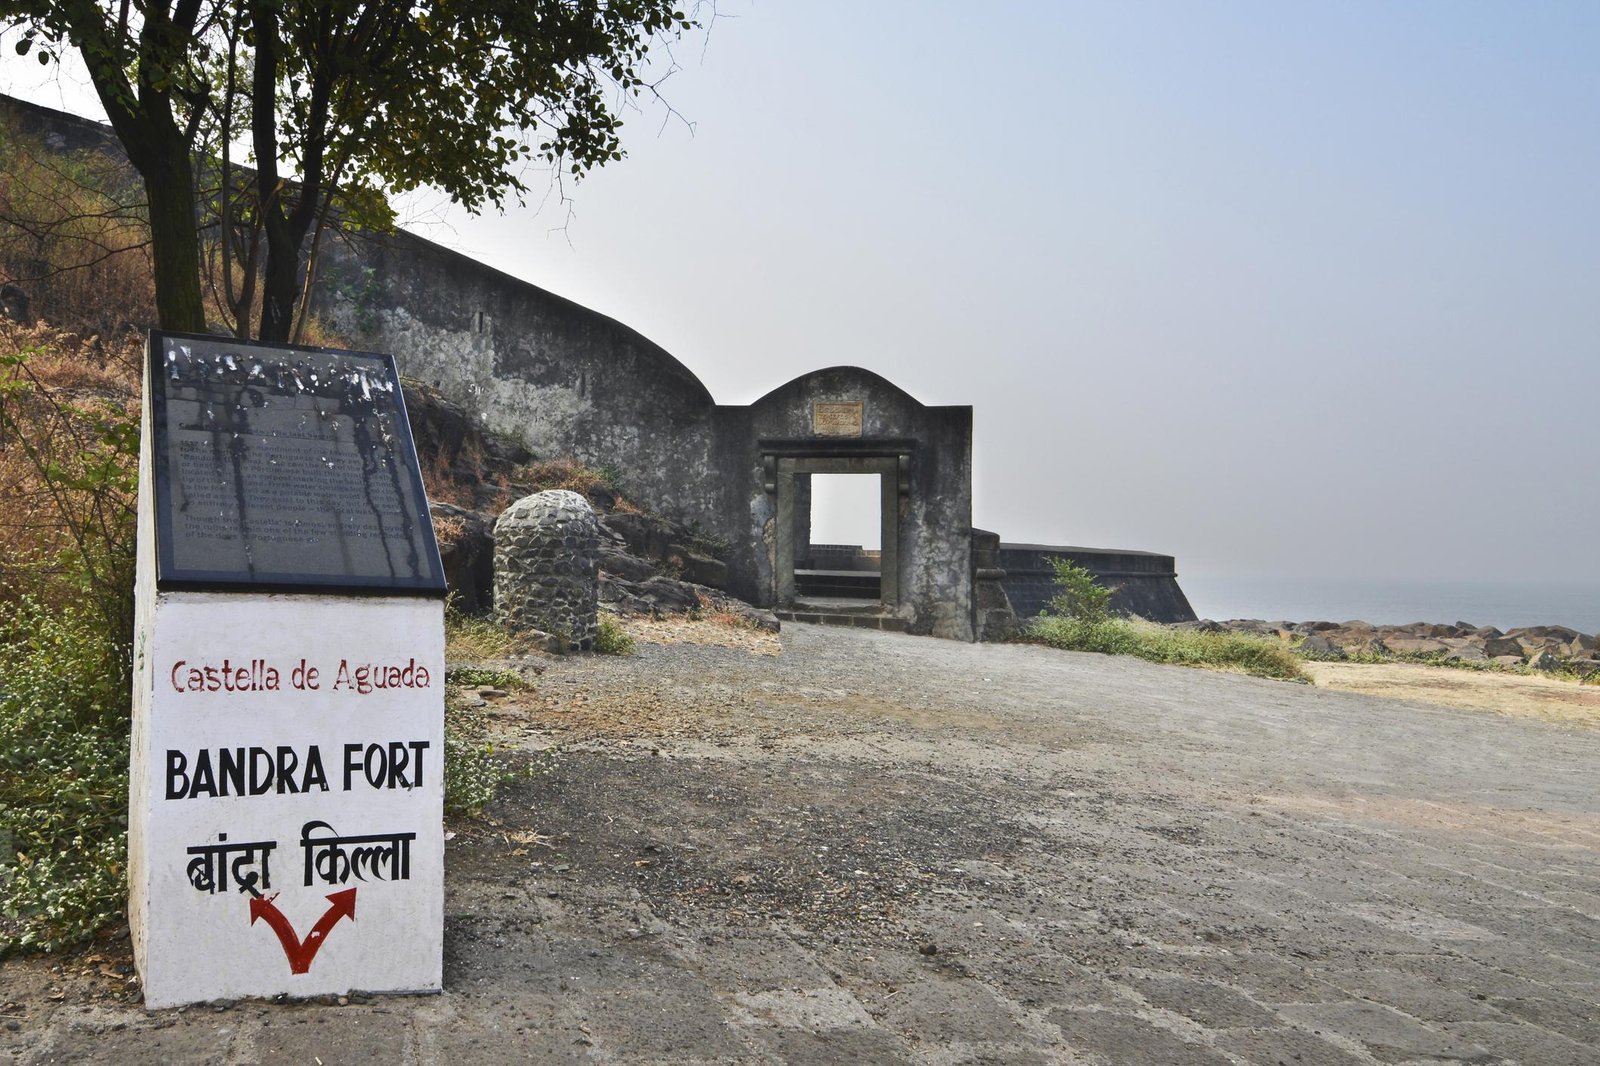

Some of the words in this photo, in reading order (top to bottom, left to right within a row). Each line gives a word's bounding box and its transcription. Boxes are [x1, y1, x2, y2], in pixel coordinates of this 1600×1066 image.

[172, 660, 279, 692] Castella
[292, 659, 319, 690] de
[333, 659, 429, 694] Aguada
[166, 746, 329, 800] BANDRA
[344, 741, 429, 791] FORT
[187, 833, 278, 897] बांद्रा
[300, 821, 416, 887] किल्ला
